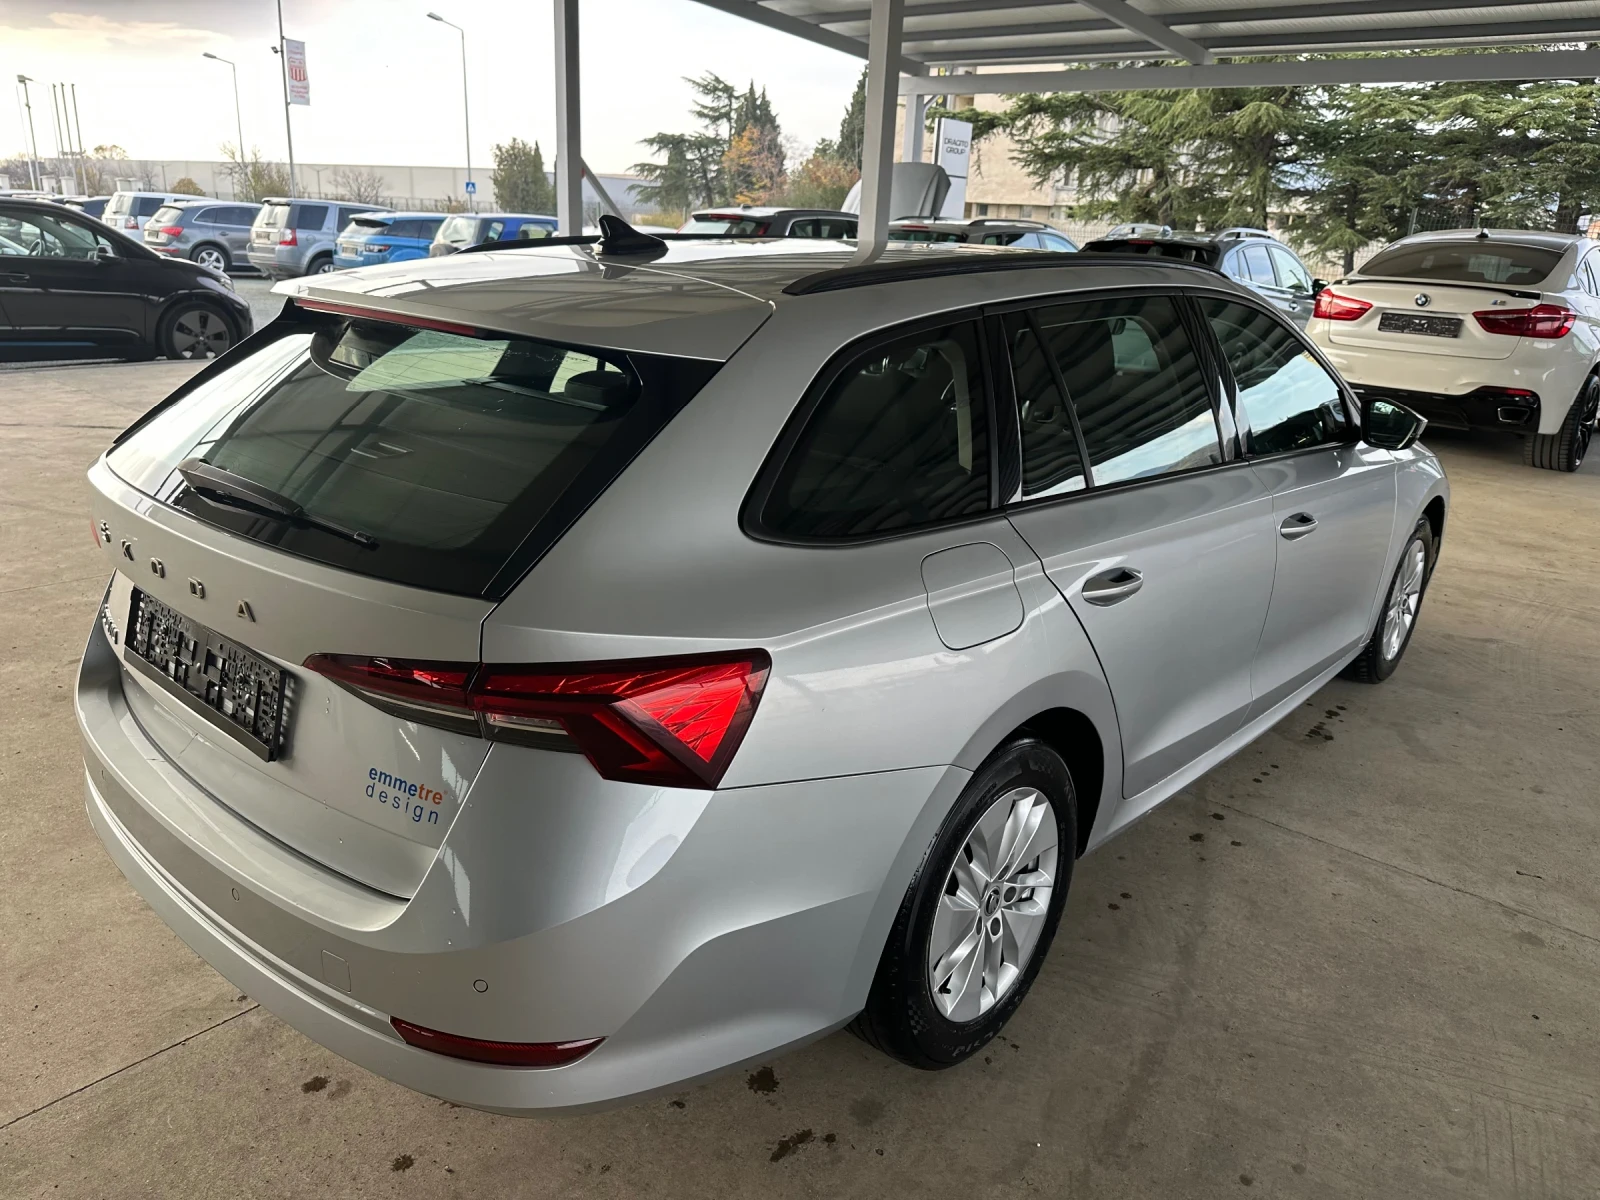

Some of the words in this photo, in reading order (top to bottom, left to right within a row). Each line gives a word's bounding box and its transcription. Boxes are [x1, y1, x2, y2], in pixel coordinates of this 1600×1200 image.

[945, 146, 966, 155] GROUP
[365, 782, 439, 824] design
[369, 767, 443, 805] emmetre
